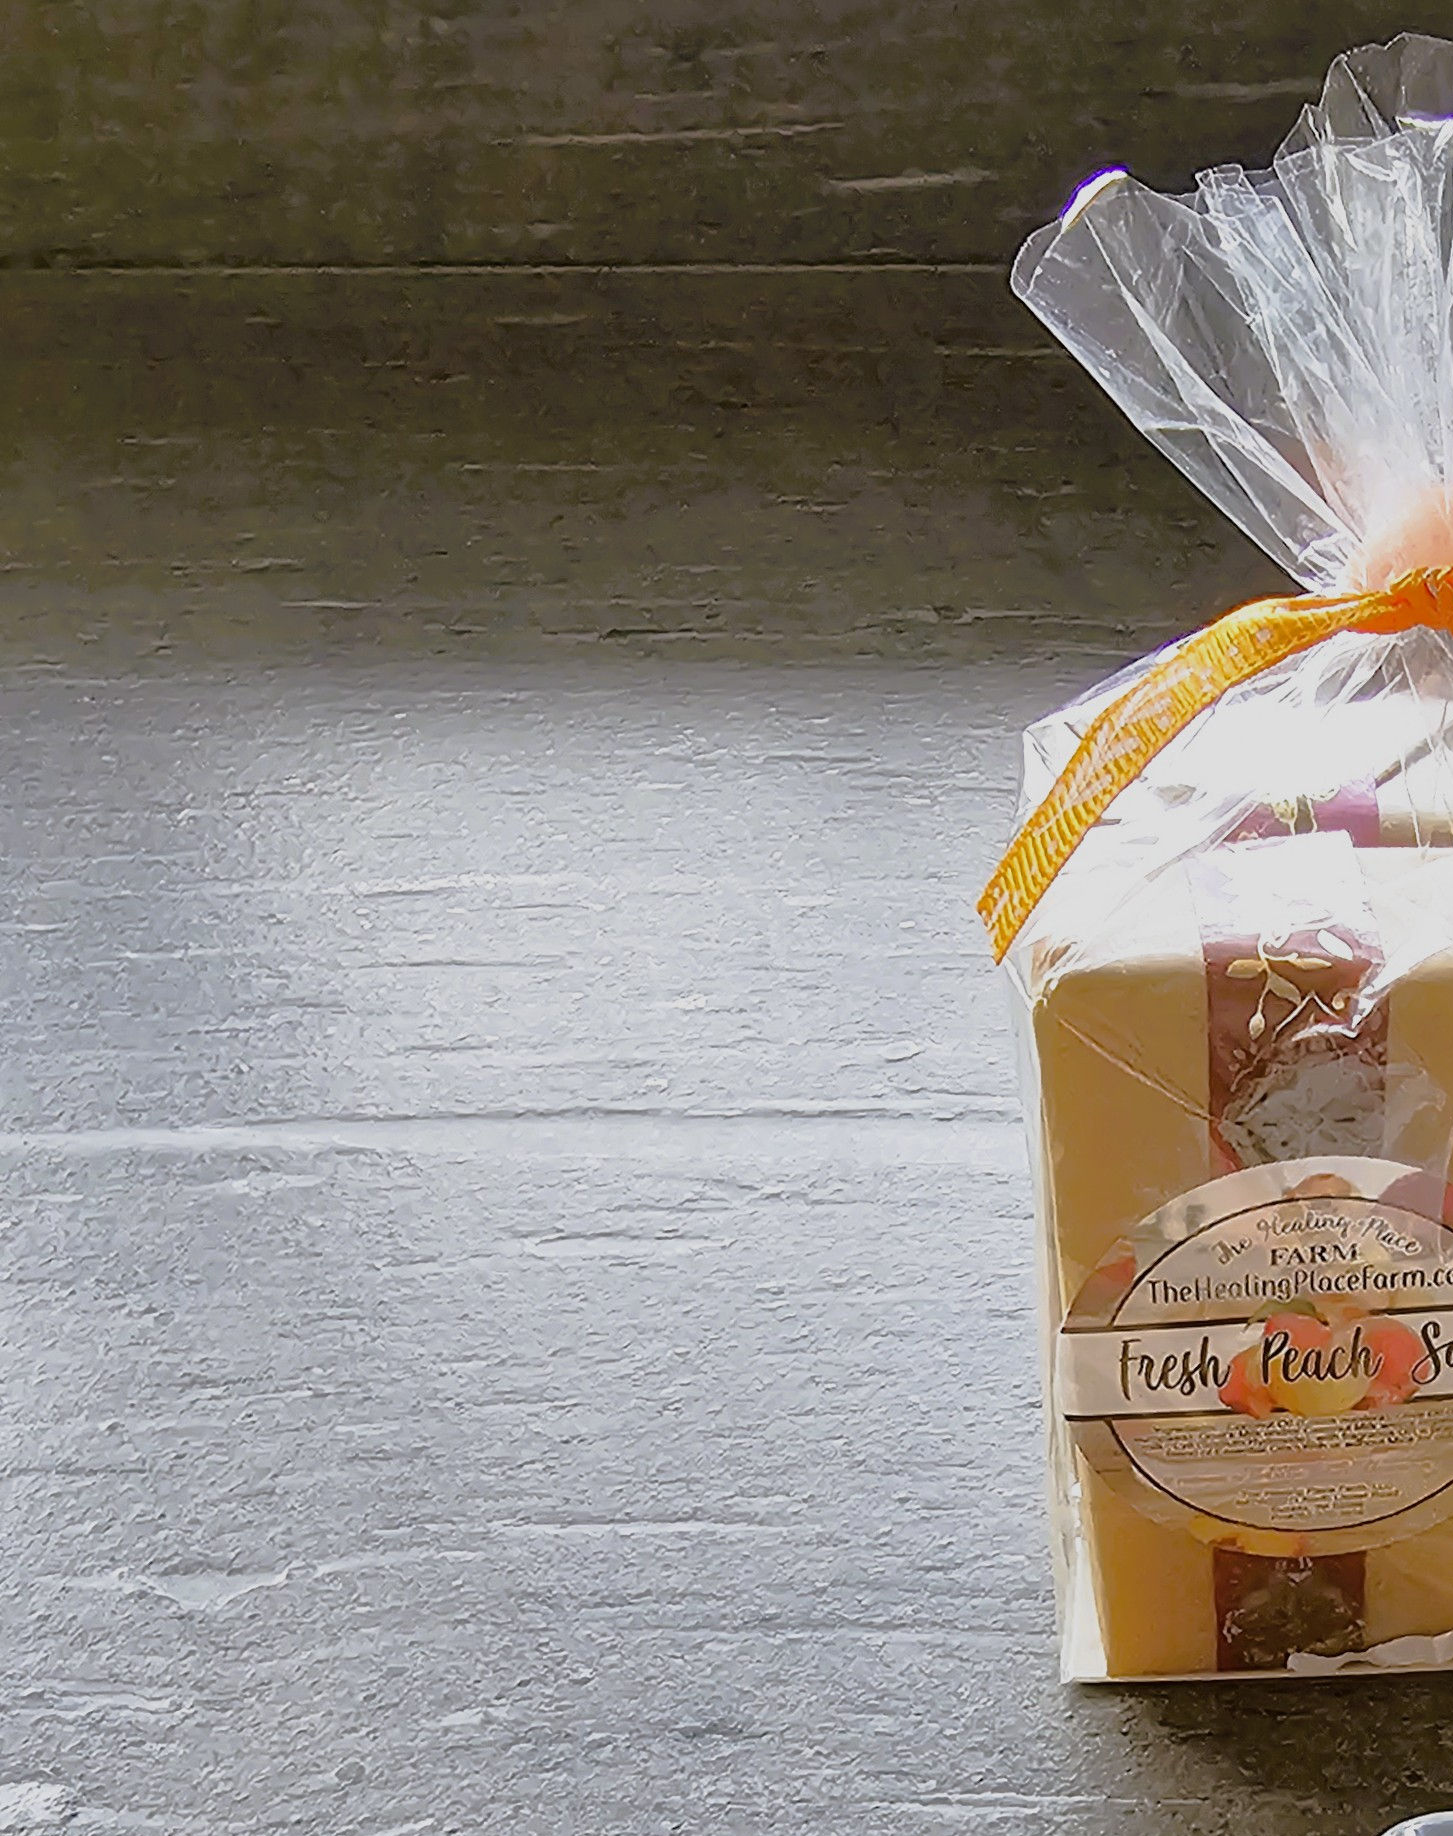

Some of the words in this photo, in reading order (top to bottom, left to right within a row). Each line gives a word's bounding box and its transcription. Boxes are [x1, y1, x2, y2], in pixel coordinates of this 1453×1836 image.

[1215, 1233, 1252, 1267] The
[1256, 1209, 1350, 1241] Healing
[1358, 1215, 1423, 1256] Place
[1270, 1244, 1362, 1267] FARM
[1119, 1335, 1235, 1401] Fresh
[1261, 1326, 1383, 1384] Peach
